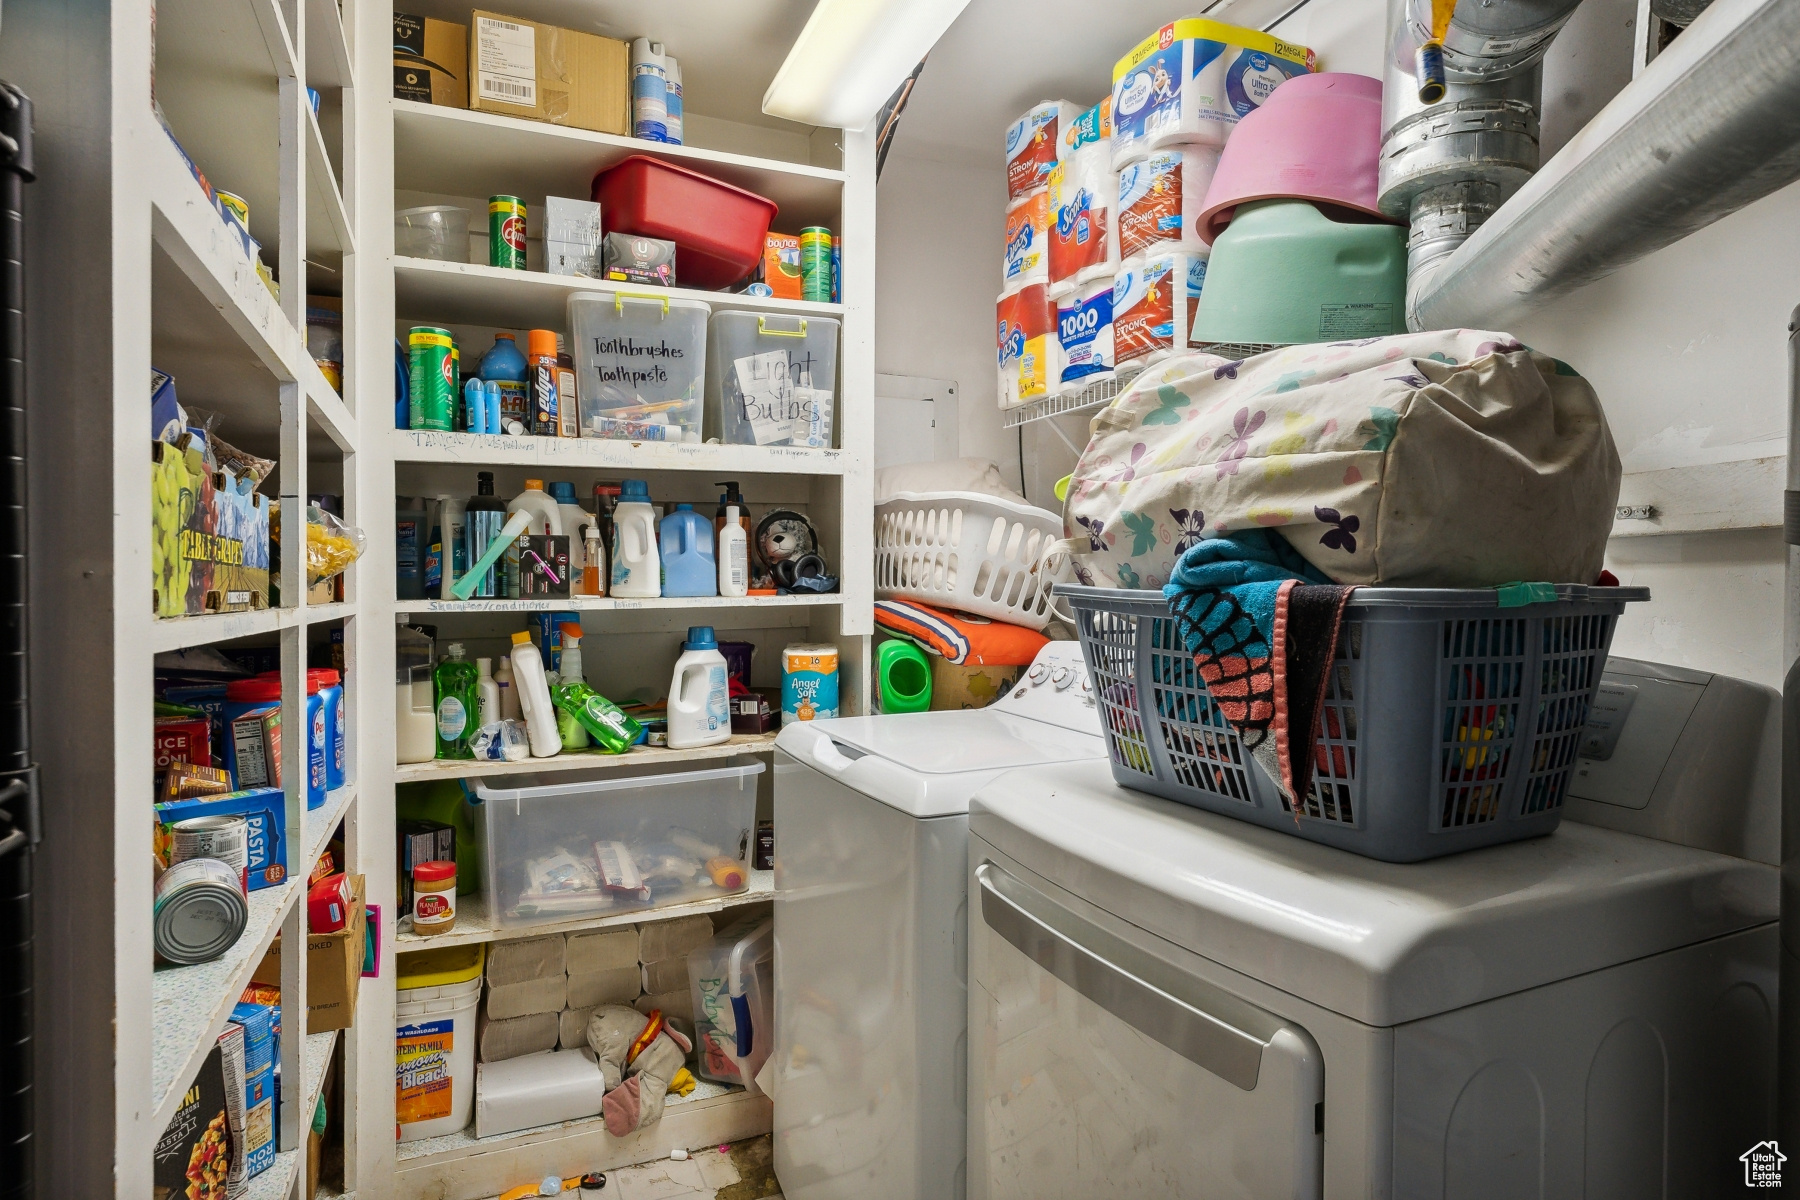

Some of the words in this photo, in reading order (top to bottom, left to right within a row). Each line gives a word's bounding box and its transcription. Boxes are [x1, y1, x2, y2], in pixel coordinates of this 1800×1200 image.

[1132, 55, 1139, 65] 12
[1138, 42, 1154, 59] MEGA
[1160, 28, 1173, 43] 48
[1274, 42, 1283, 54] 12
[1283, 45, 1300, 58] MEGA
[1250, 56, 1266, 65] Great
[1252, 80, 1268, 91] Ultra
[1258, 74, 1276, 84] Premium
[1254, 90, 1264, 98] Bath
[1088, 108, 1096, 138] Angel
[1063, 188, 1086, 232] Scott
[1122, 210, 1154, 232] STRONG
[638, 242, 648, 254] U
[767, 237, 797, 248] bounce
[1061, 308, 1098, 337] 1000
[1062, 335, 1076, 344] SHEETS
[1085, 328, 1096, 337] ROLL
[593, 337, 684, 358] Toothbrushes
[594, 365, 668, 388] Toothpaste
[753, 351, 818, 399] Light
[535, 367, 552, 412] edge
[742, 387, 819, 422] Bulbs
[182, 530, 212, 560] TABLE
[214, 538, 244, 566] GRAPES
[794, 656, 800, 665] 4
[810, 656, 821, 665] 16
[792, 678, 821, 690] Angel
[797, 688, 817, 698] Soft
[154, 737, 186, 749] ICE
[154, 754, 187, 766] ONI
[248, 817, 264, 868] PASTA
[428, 906, 446, 914] BUTTER
[308, 941, 332, 950] OKED
[316, 1002, 340, 1010] BREAST
[696, 978, 725, 1024] Baby
[396, 1045, 416, 1056] STERN
[419, 1040, 444, 1052] FAMILY
[396, 1050, 446, 1074] conom
[172, 1102, 200, 1122] ACARONI
[155, 1132, 184, 1151] PASTA
[248, 1143, 273, 1167] RON
